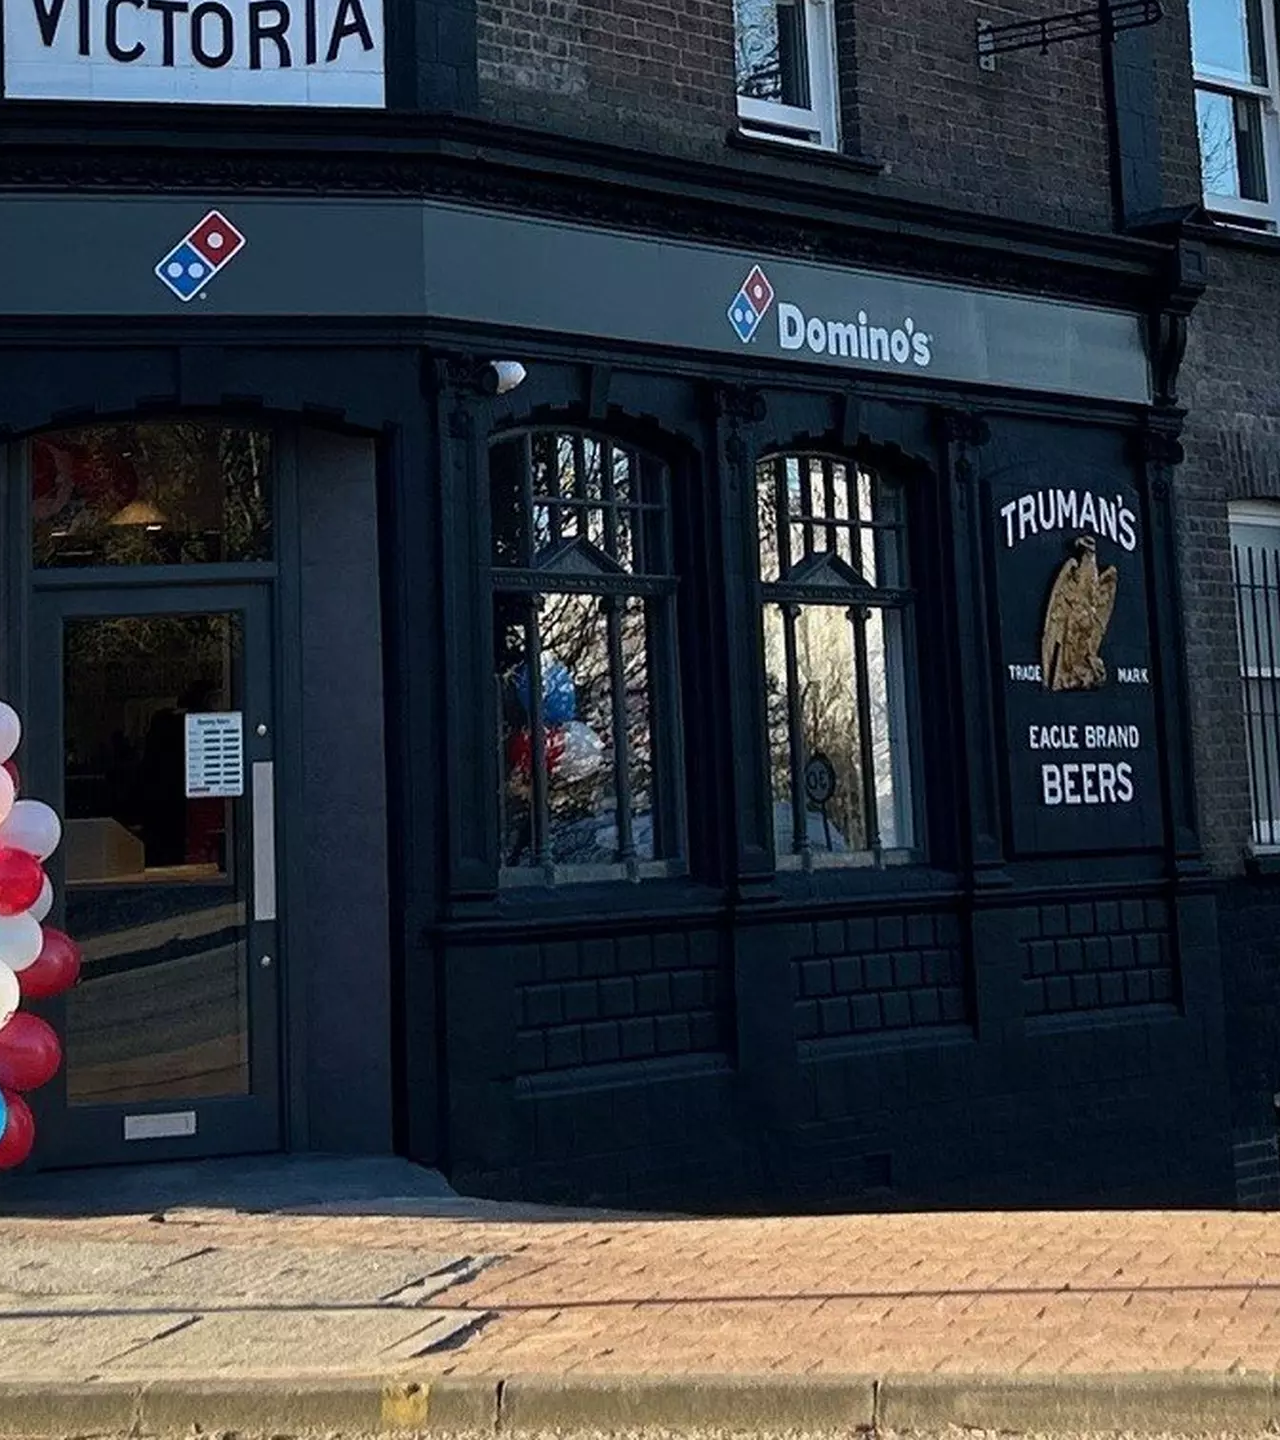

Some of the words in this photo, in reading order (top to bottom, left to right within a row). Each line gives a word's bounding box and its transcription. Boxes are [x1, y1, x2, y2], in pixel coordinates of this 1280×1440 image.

[778, 303, 931, 366] Domino's
[1000, 488, 1136, 551] TRUMAN'S
[1008, 665, 1042, 682] TRADE
[1118, 667, 1149, 683] MARK
[1084, 725, 1139, 749] BRAND
[1042, 761, 1133, 804] BEERS
